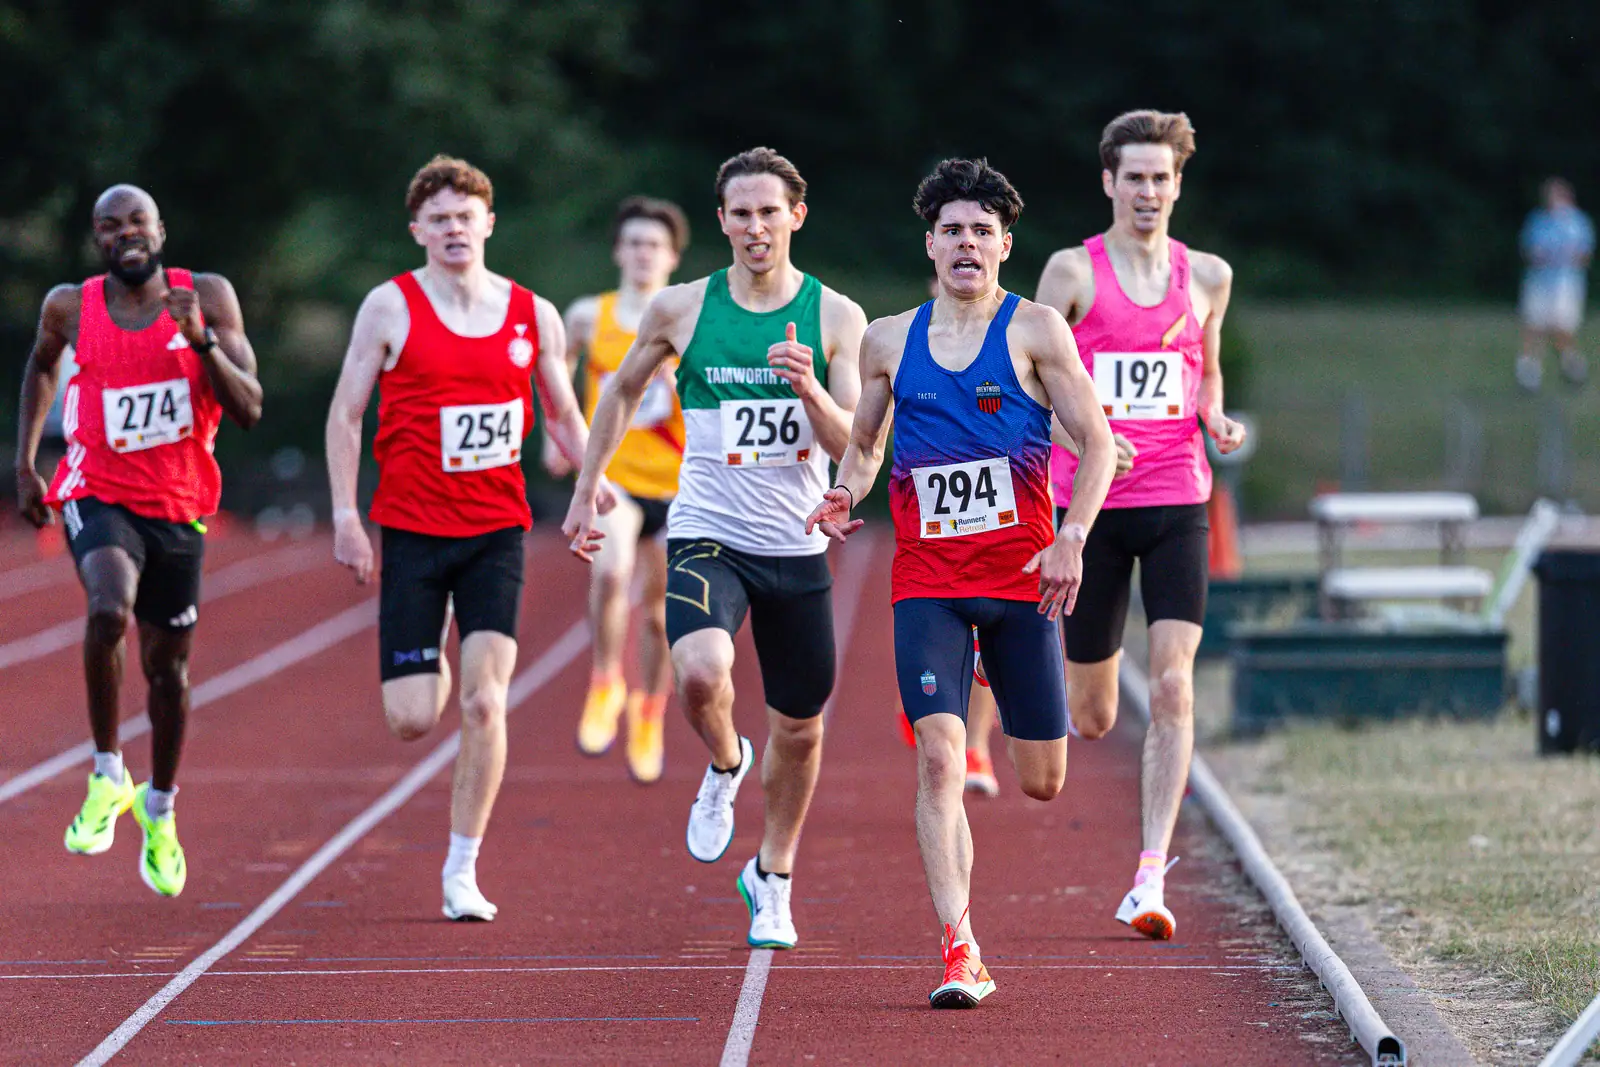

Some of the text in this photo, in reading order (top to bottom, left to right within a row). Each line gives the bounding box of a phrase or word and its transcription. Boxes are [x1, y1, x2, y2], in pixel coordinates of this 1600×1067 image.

[705, 366, 777, 385] TAMWORTH
[1115, 360, 1167, 398] 192
[118, 387, 177, 430] 274
[917, 392, 937, 400] TACTIC
[456, 410, 511, 450] 254
[736, 406, 800, 447] 256
[928, 466, 997, 515] 294
[958, 515, 987, 526] Runners'
